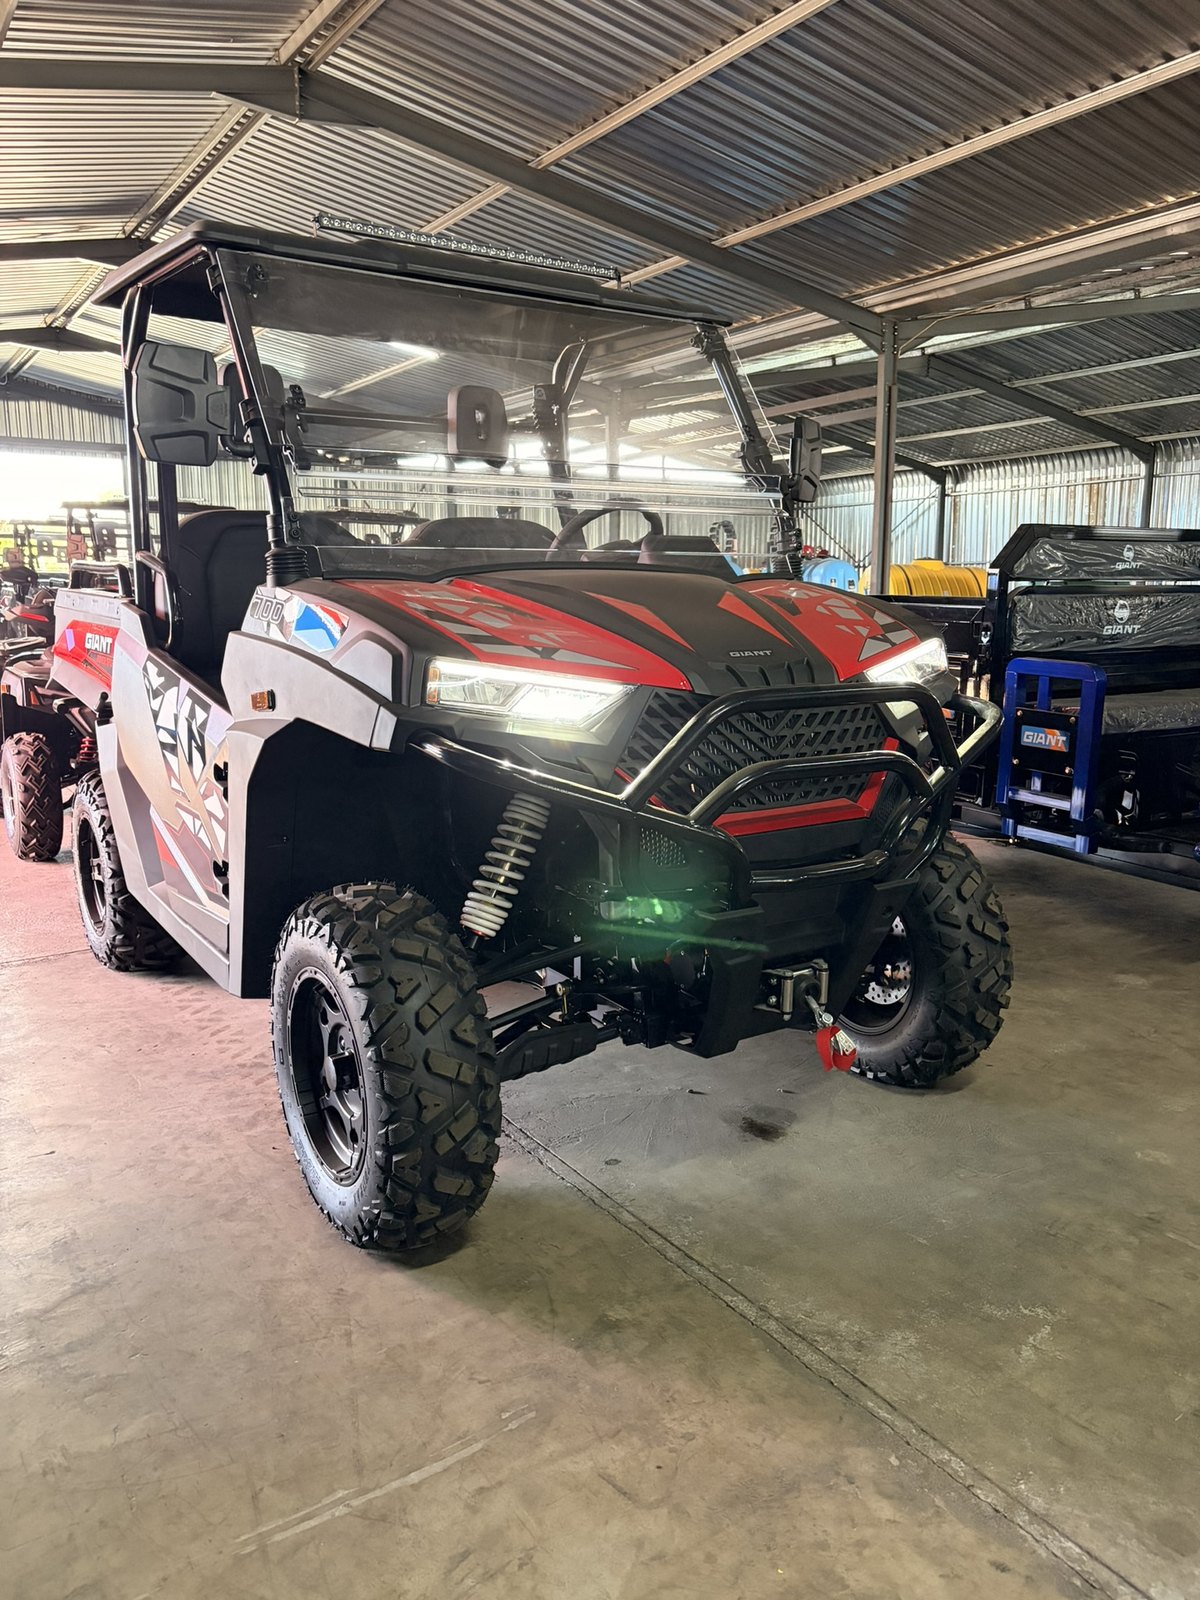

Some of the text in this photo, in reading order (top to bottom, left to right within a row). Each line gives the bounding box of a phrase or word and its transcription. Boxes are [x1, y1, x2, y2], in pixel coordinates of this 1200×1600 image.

[1115, 562, 1141, 570] GIANT
[252, 596, 285, 623] 700
[1103, 625, 1141, 635] GIANT
[84, 632, 113, 654] GIANT
[1023, 731, 1067, 747] GIANT
